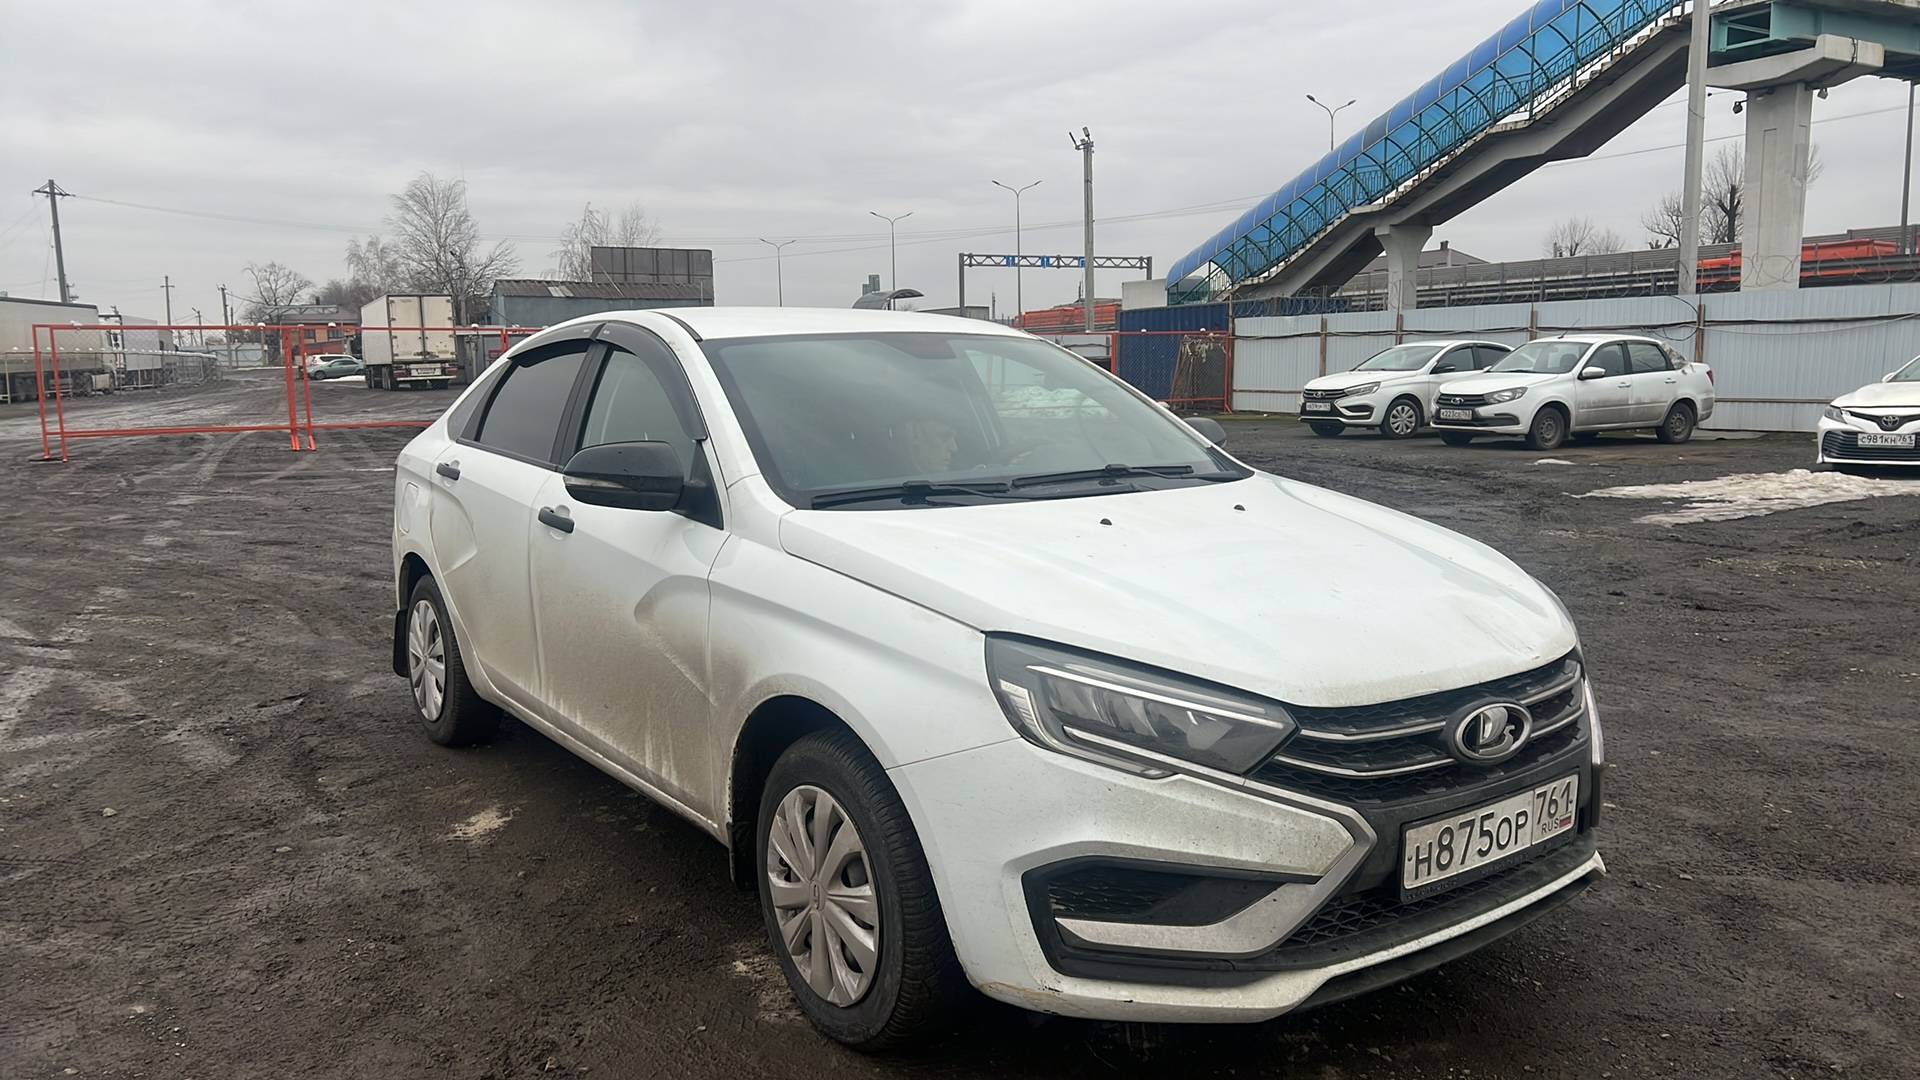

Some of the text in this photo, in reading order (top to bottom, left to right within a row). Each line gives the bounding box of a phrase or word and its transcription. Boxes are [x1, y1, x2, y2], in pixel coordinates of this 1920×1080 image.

[1414, 780, 1572, 880] Н875ОР 761
[1541, 818, 1560, 835] RUS
